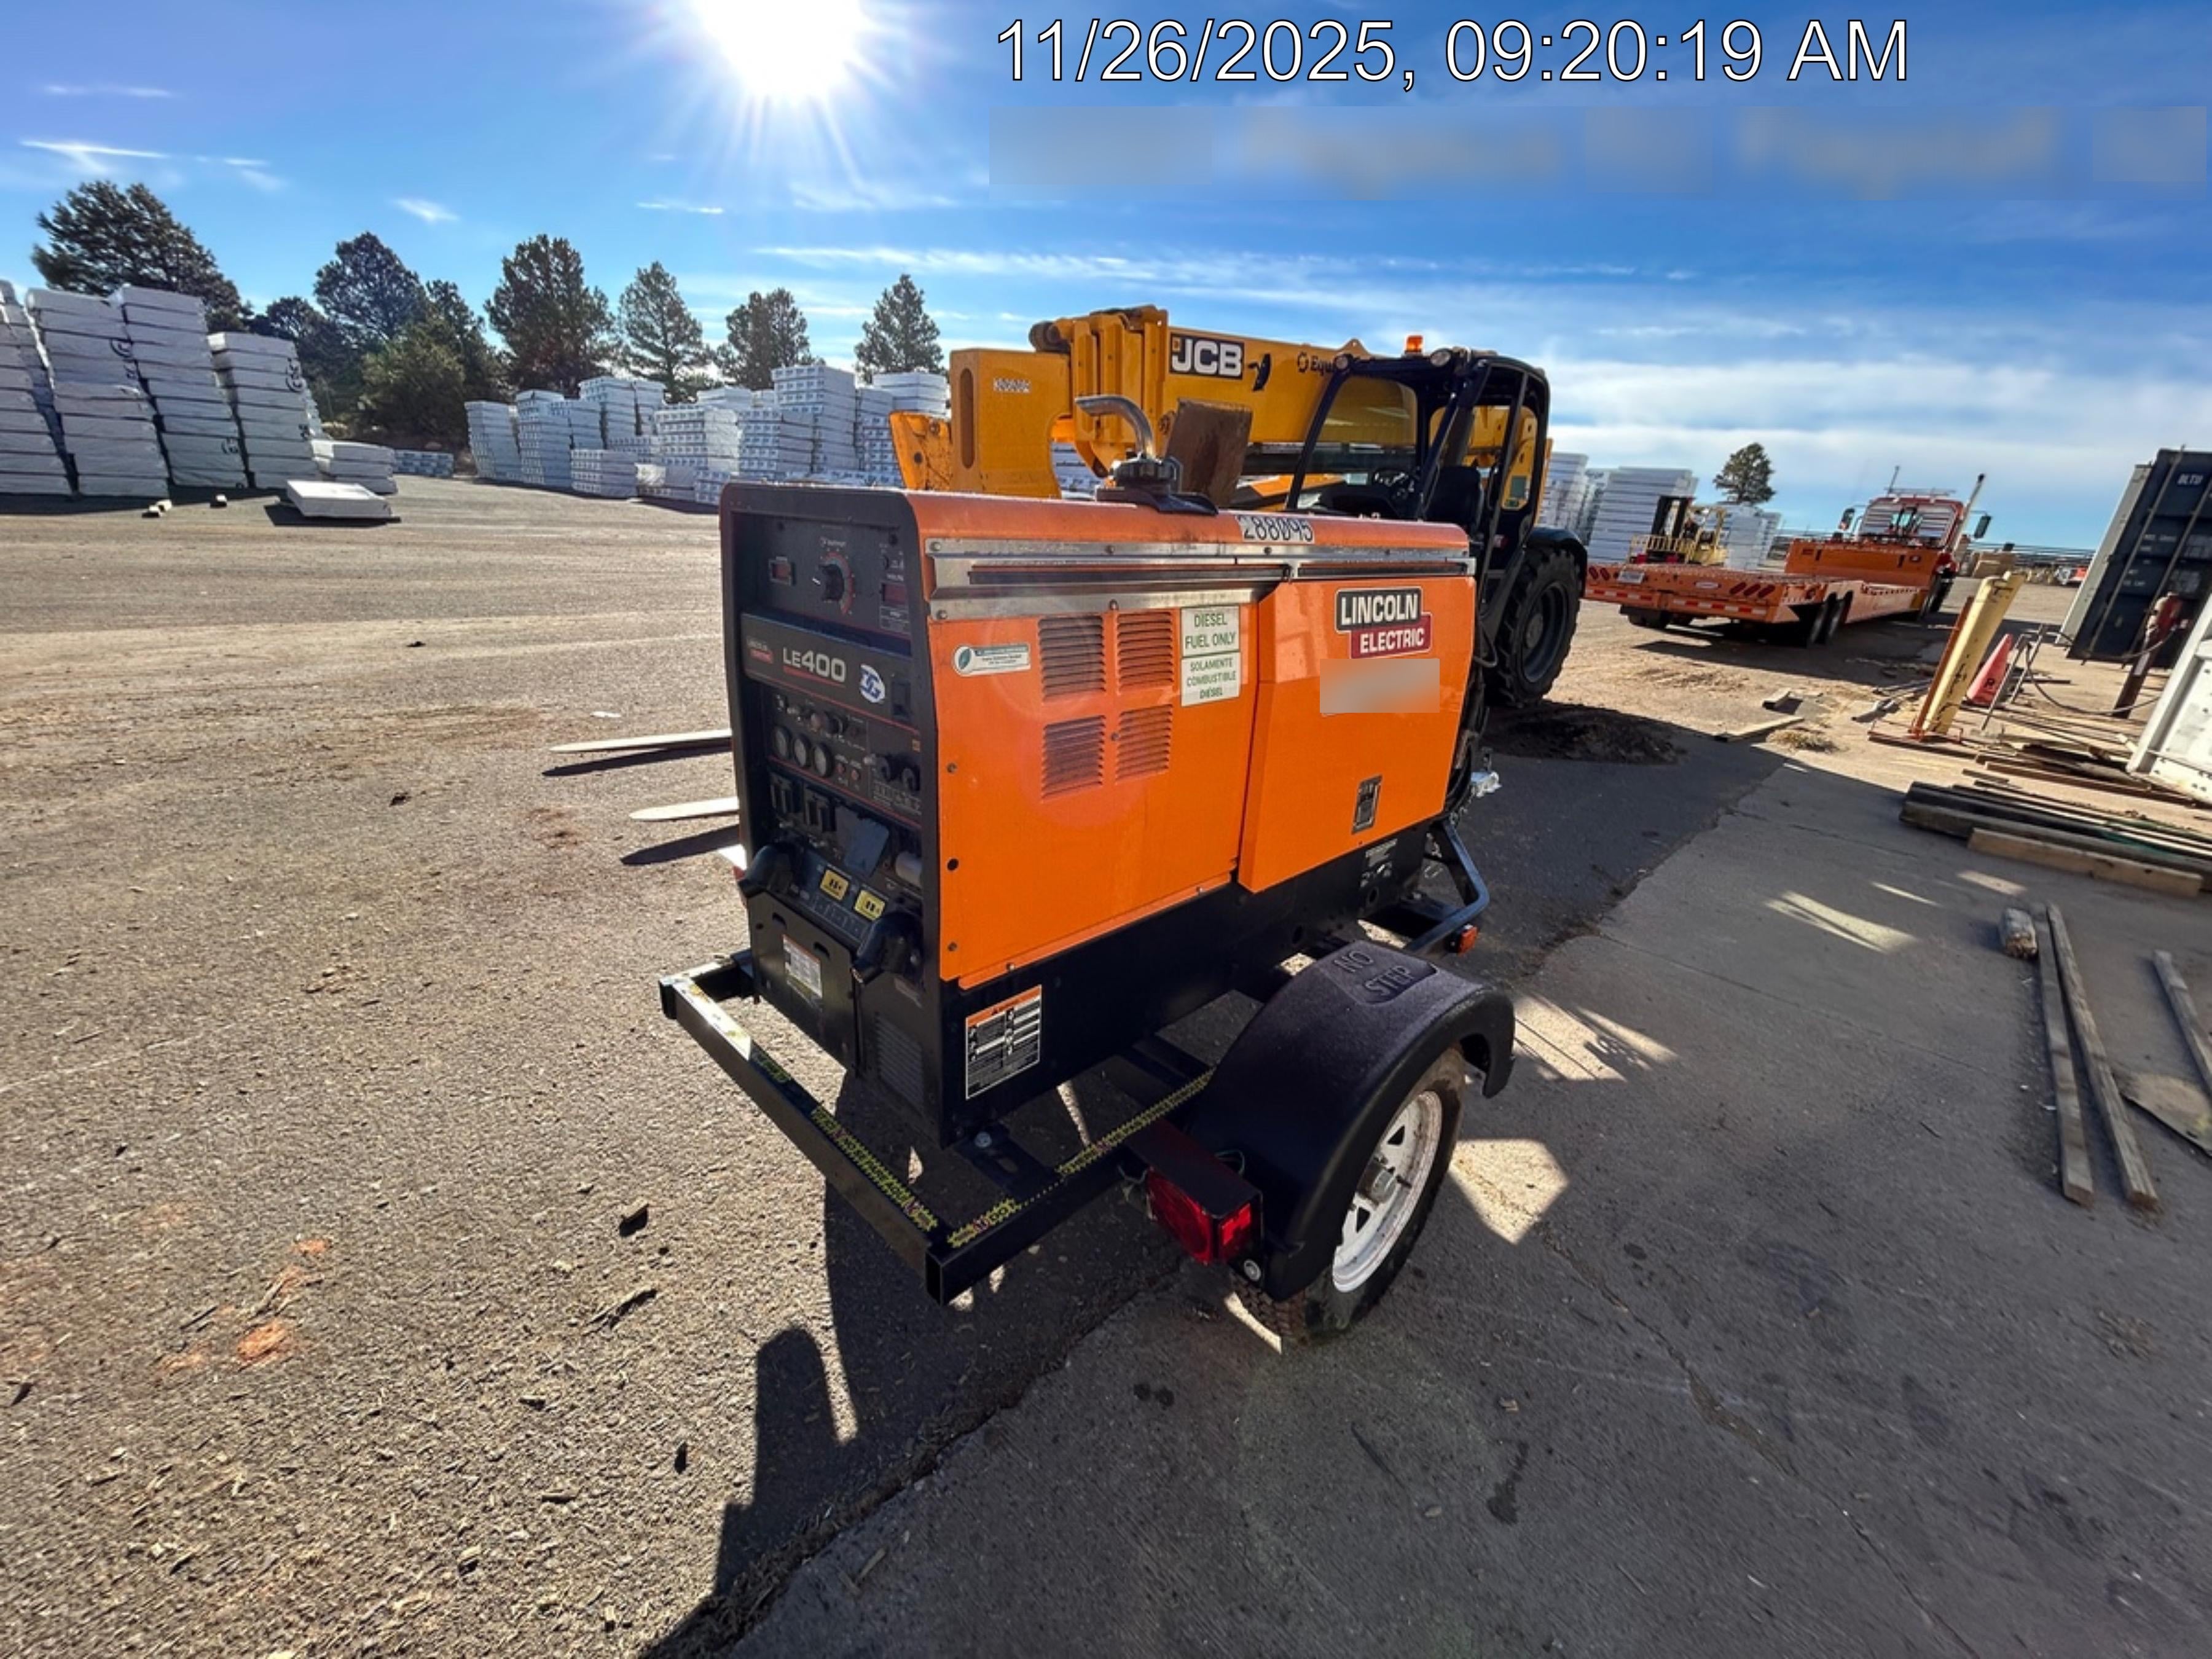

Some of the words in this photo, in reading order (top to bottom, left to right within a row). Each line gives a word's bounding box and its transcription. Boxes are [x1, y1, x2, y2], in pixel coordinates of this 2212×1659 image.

[1172, 339, 1242, 377] JCB
[1194, 613, 1228, 627] DIESEL
[1341, 593, 1419, 626] LINCOLN
[1185, 634, 1209, 649] FUEL
[1212, 631, 1236, 646] ONLY
[1359, 627, 1424, 654] ELECTRIC
[783, 647, 846, 683] LE400
[1190, 657, 1233, 672] SOLAMENTE
[1186, 670, 1236, 687] COMBUSTIBLE
[1333, 951, 1375, 973] NO
[1363, 965, 1414, 997] STEP
